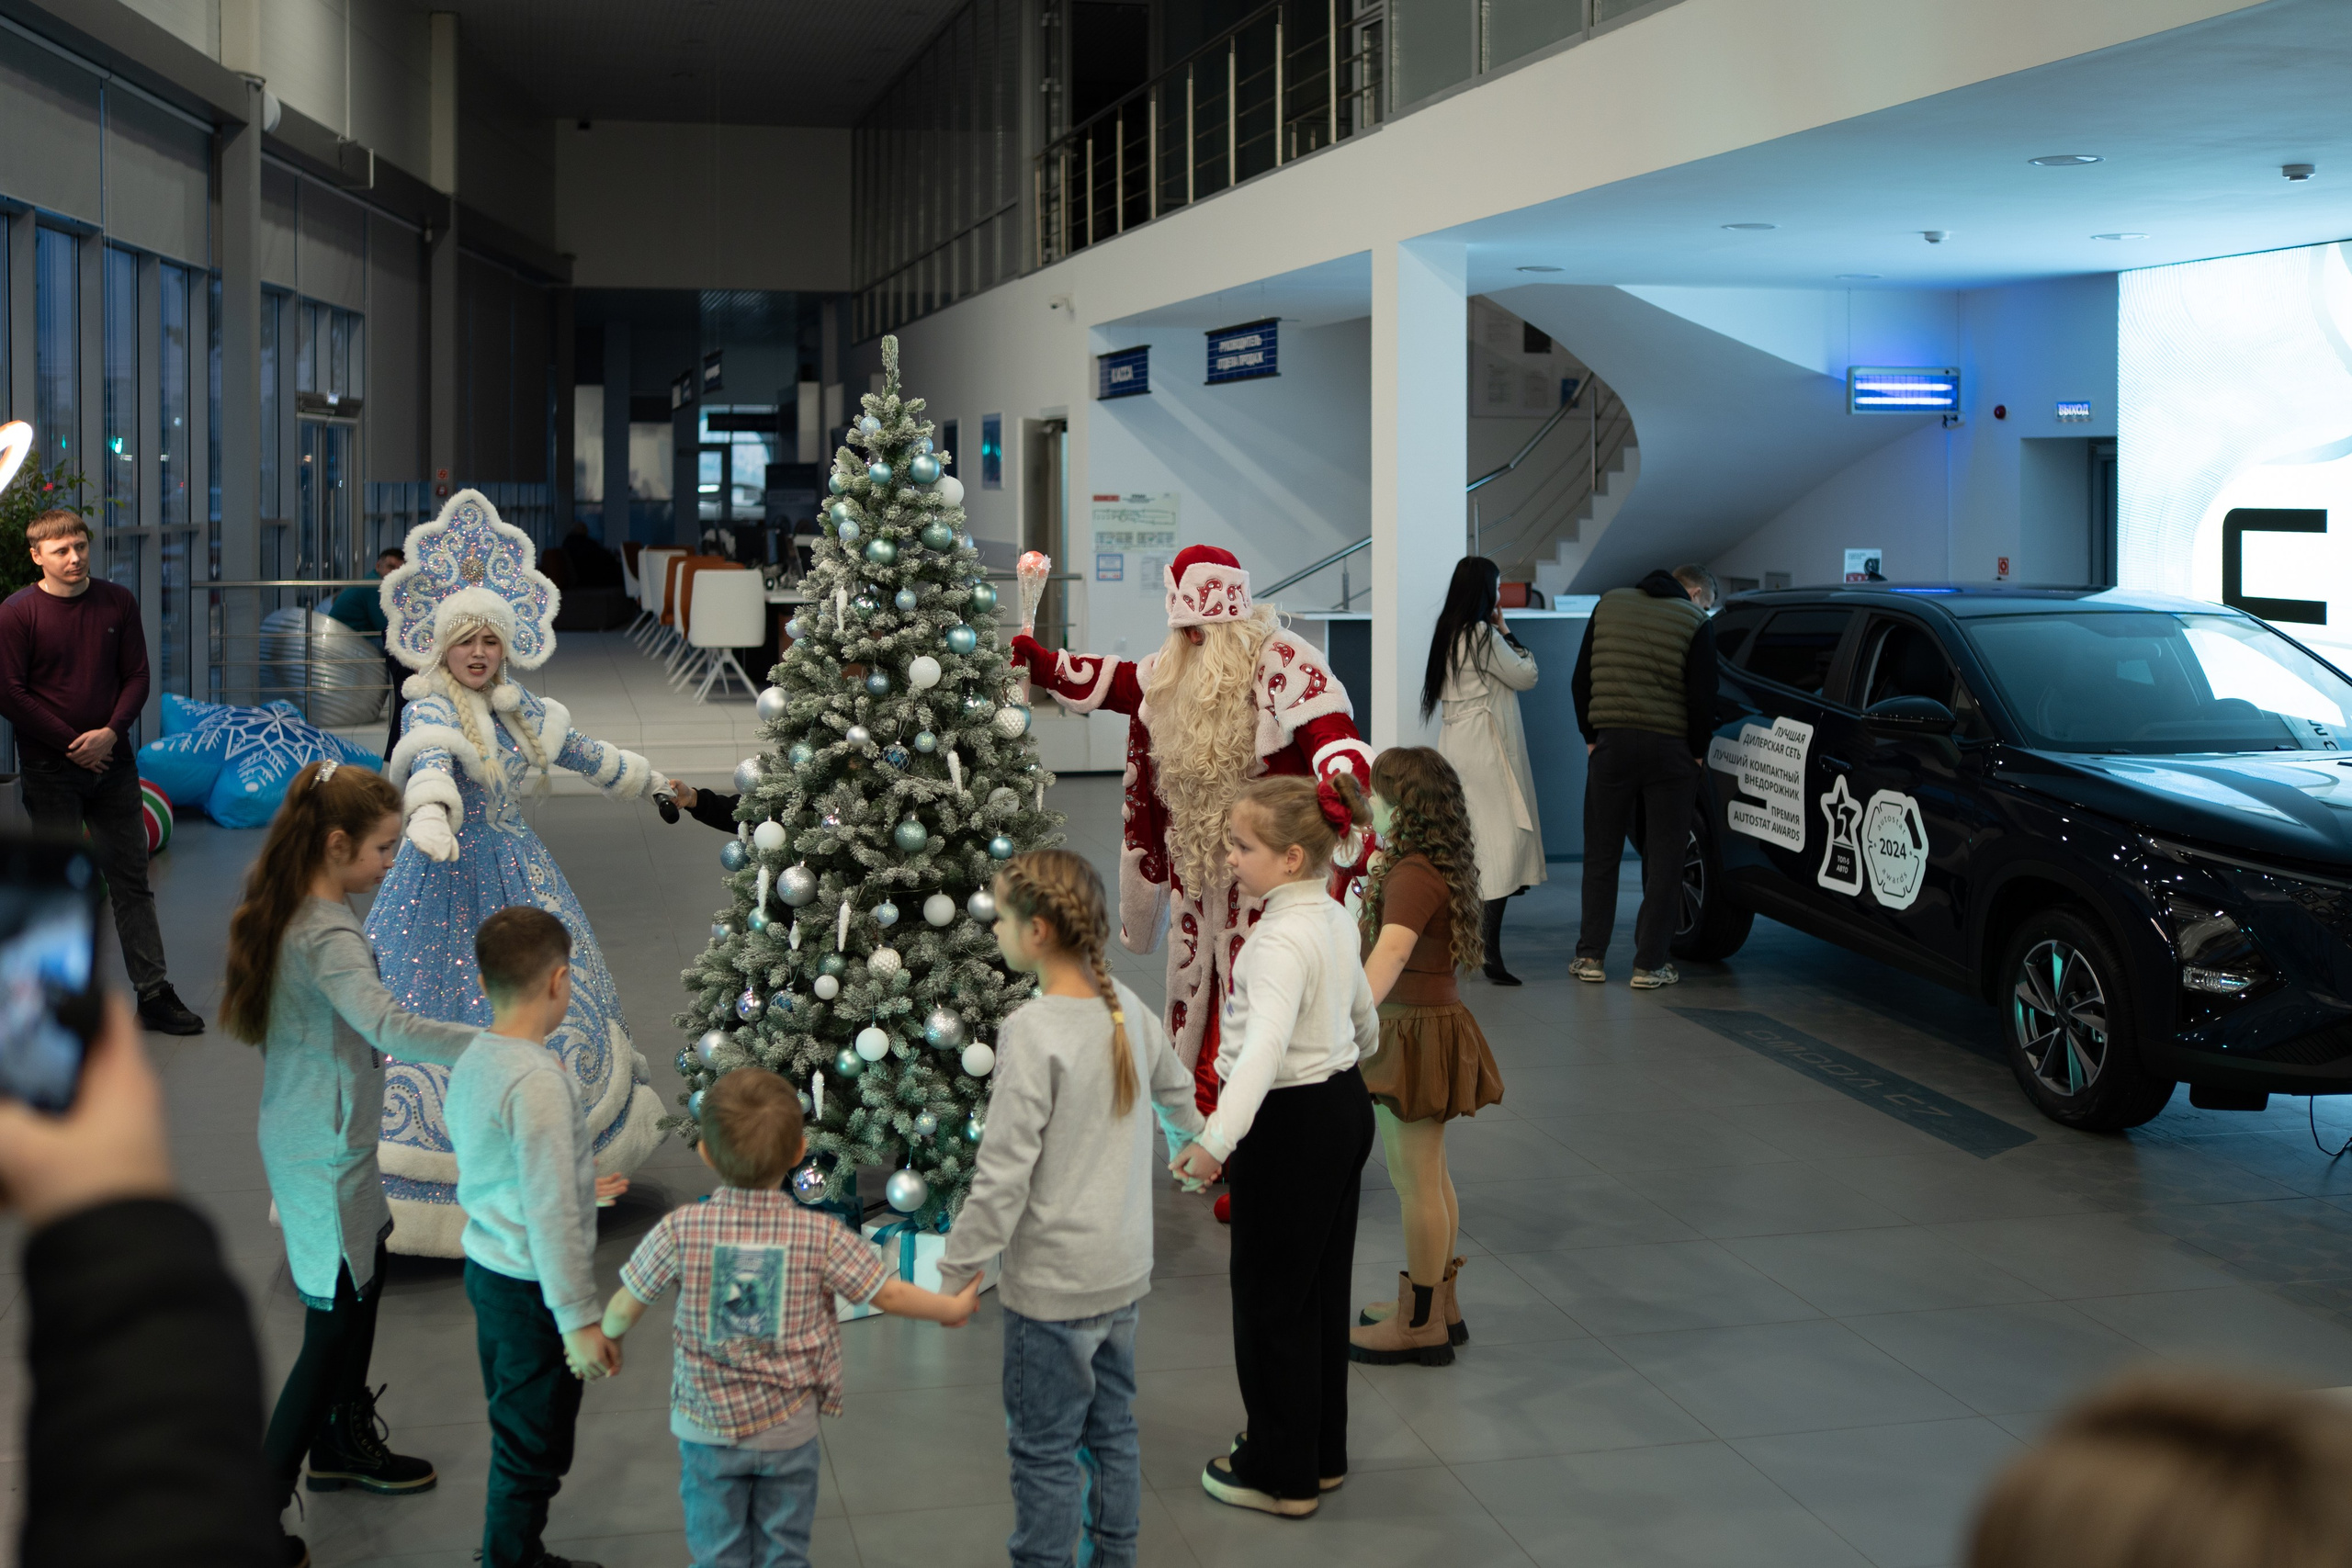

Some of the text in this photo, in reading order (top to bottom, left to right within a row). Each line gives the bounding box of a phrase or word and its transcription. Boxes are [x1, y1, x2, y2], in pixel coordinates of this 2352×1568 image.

[2058, 403, 2089, 416] ВЫХОД
[1774, 727, 1806, 744] ЛУЧШАЯ
[1743, 733, 1802, 761] ДИЛЕРСКАЯ СЕТЬ
[1713, 749, 1800, 785] ЛУЧШИЙ КОМПАКТНЫЙ
[1745, 773, 1800, 801] ВНЕДОРОЖНИК
[1734, 810, 1801, 842] AUTOSTAT AWARDS
[1771, 806, 1801, 826] ПРЕМИЯ
[1877, 815, 1906, 835] autostat
[1879, 838, 1907, 861] 2024
[1836, 864, 1849, 874] АВТО
[1837, 855, 1850, 866] ТОП-5
[1882, 867, 1908, 884] awards
[1745, 1030, 1883, 1089] OMODA
